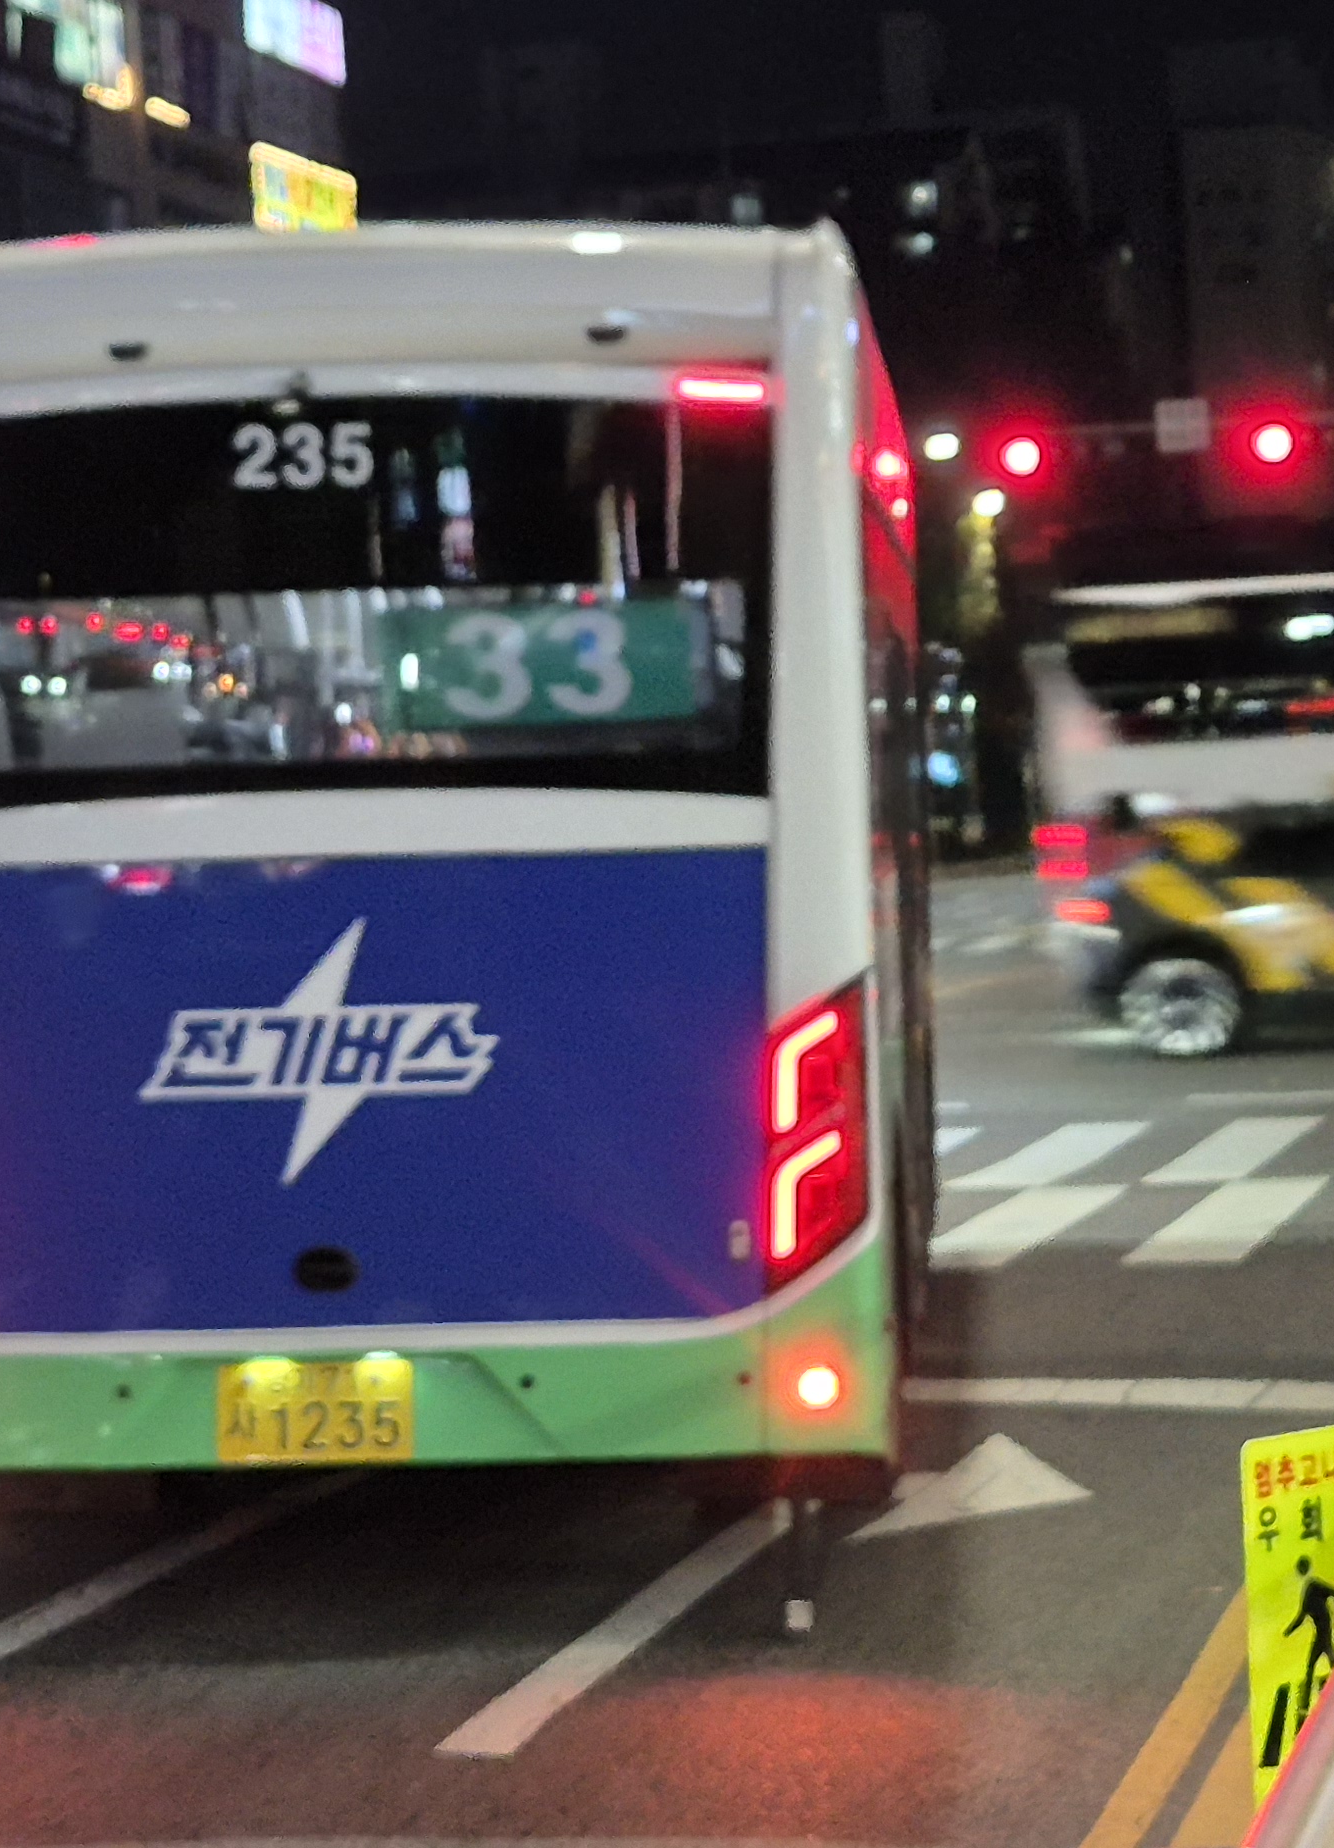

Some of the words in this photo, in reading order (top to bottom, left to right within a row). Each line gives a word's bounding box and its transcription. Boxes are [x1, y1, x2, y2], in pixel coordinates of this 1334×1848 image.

[230, 420, 375, 490] 235
[444, 611, 635, 720] 33
[161, 1012, 475, 1089] 전기버스
[270, 1399, 401, 1450] 1235
